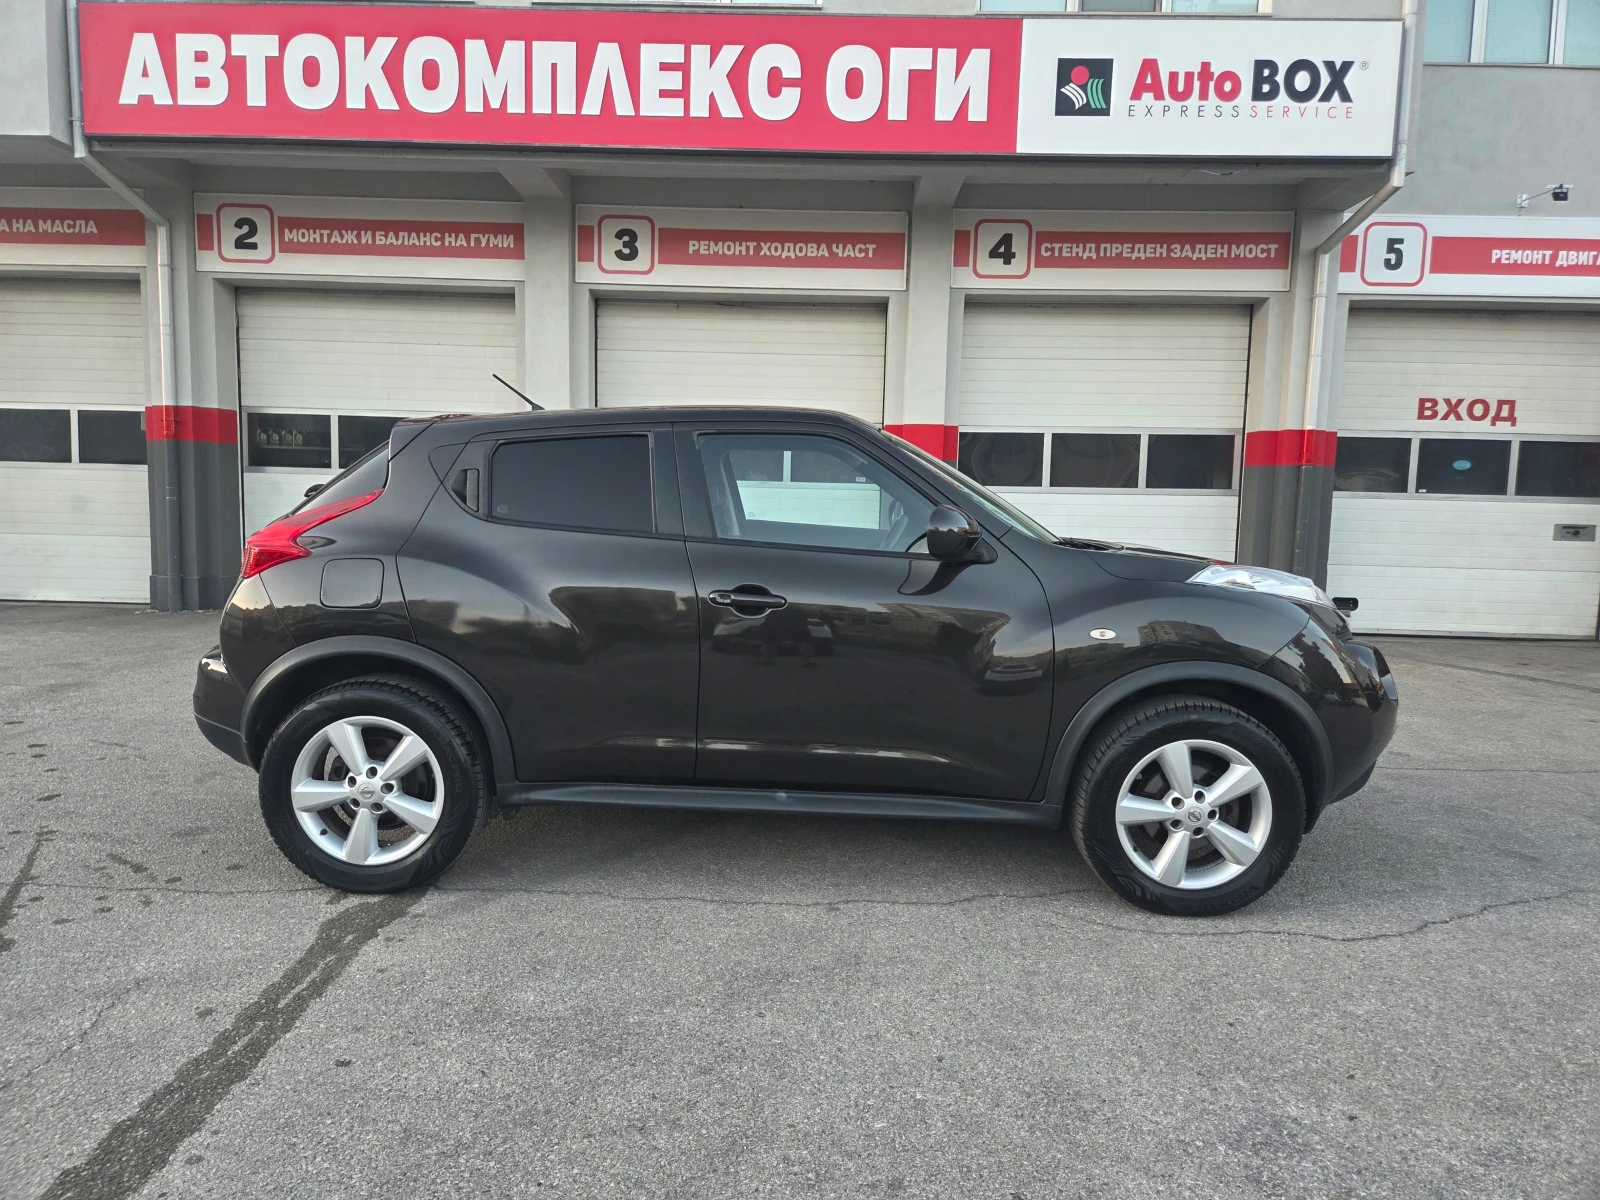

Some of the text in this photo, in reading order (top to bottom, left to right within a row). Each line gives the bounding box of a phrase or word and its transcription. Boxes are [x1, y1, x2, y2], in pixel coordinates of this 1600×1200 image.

[119, 33, 990, 122] АВТОКОМПЛЕКС ОГИ
[1130, 58, 1242, 103] Auto
[1251, 59, 1354, 103] BOX
[12, 219, 36, 232] НА
[38, 219, 98, 234] МАСЛА
[234, 217, 258, 250] 2
[284, 228, 514, 248] МОНТАЖ И БАЛАНС НА ГУМИ
[614, 228, 639, 262] 3
[688, 240, 877, 259] РЕМОНТ ХОДОВА ЧАСТ
[988, 232, 1016, 265] 4
[1040, 242, 1278, 260] СТЕНД ПРЕДЕН ЗАДЕН МОСТ
[1383, 238, 1405, 271] 5
[1491, 249, 1553, 265] РЕМОНТ
[1417, 397, 1517, 427] ВХОД
